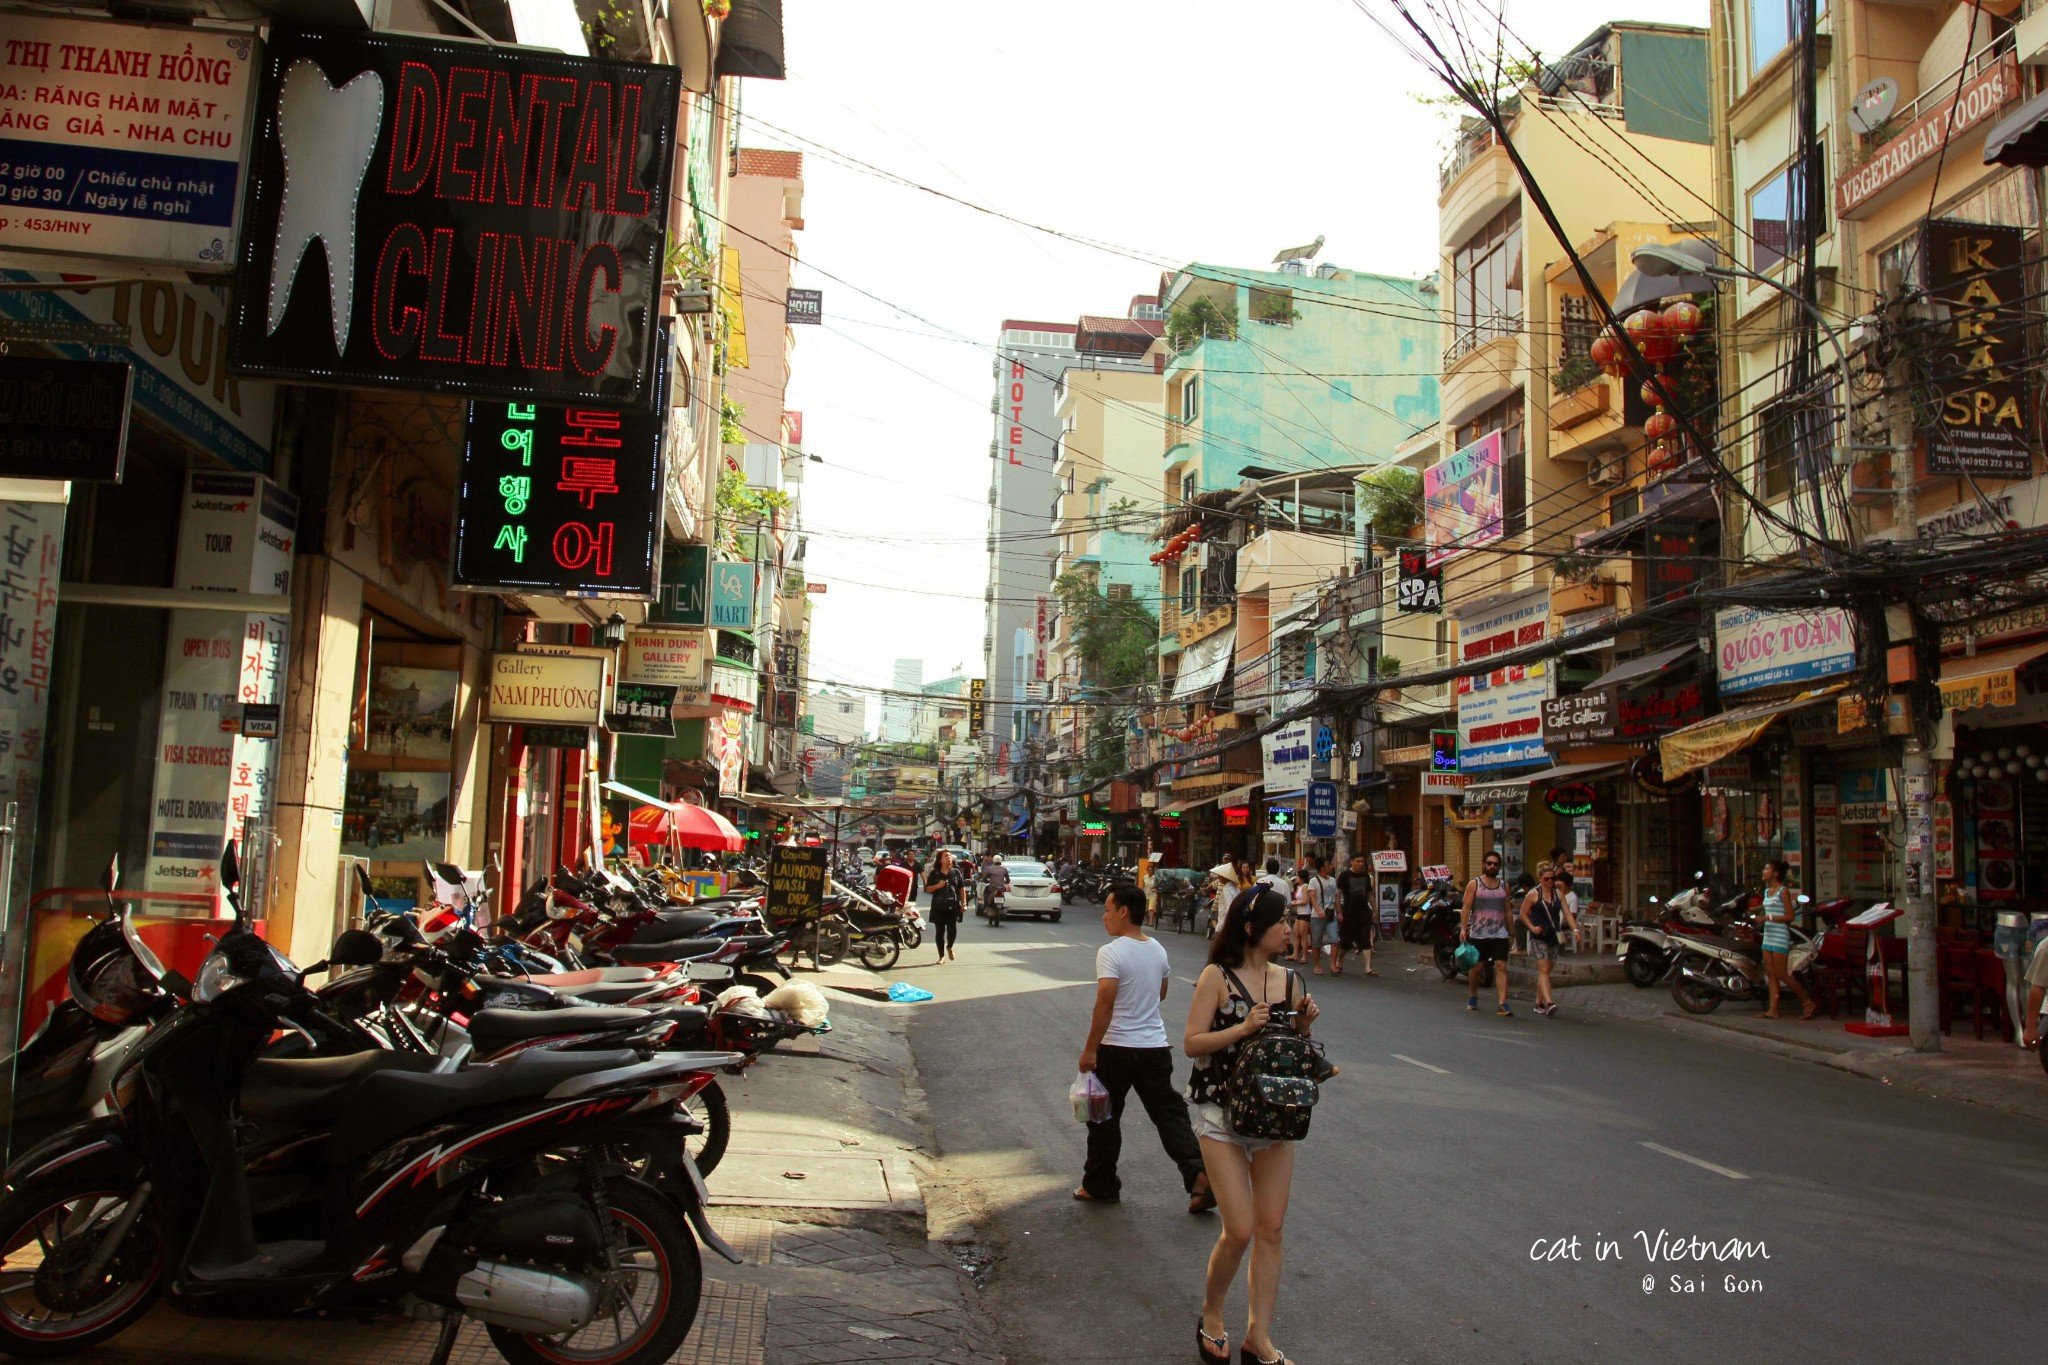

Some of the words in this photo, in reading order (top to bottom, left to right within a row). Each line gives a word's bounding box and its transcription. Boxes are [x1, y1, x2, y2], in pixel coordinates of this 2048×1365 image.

[6, 40, 51, 73] THỊ
[60, 44, 151, 79] THANH
[157, 42, 231, 86] HỒNG
[34, 84, 100, 109] RĂNG
[109, 90, 160, 114] HÀM
[167, 97, 218, 119] MẶT
[66, 113, 104, 136] GIẢ
[128, 123, 175, 144] NHA
[183, 128, 232, 148] CHU
[385, 60, 652, 217] DENTAL
[1841, 117, 1940, 207] VEGETARIAN
[1943, 73, 2004, 138] FOODS
[14, 164, 41, 180] giờ
[45, 166, 65, 181] 00
[88, 169, 137, 188] Chiều
[141, 174, 172, 192] chủ
[177, 179, 214, 197] nhật
[11, 185, 38, 202] giờ
[42, 188, 62, 202] 30
[84, 191, 128, 210] Ngày
[24, 218, 91, 236] 453/HNY
[371, 221, 623, 377] CLINIC
[789, 300, 819, 314] HOTEL
[1009, 359, 1025, 465] HOTEL
[1942, 389, 2024, 430] SPA
[192, 500, 233, 511] Jetstar
[205, 533, 233, 553] TOUR
[1400, 578, 1441, 606] SPA
[713, 605, 748, 624] MART
[183, 638, 209, 658] OPEN
[212, 639, 231, 659] BUS
[1722, 621, 1776, 672] QUỐC
[643, 652, 691, 663] GALLERY
[497, 658, 544, 680] Gallery
[1988, 675, 2008, 690] 138
[168, 690, 198, 711] TRAIN
[492, 684, 528, 707] NAM
[531, 684, 598, 710] PHƯƠNG
[972, 680, 985, 731] HOTEL
[250, 721, 273, 731] VISA
[1548, 710, 1572, 728] Cafe
[164, 744, 184, 764] VISA
[187, 746, 232, 767] SERVICES
[1434, 750, 1457, 769] Spa
[1428, 774, 1474, 786] INTERNET
[157, 798, 186, 819] HOTEL
[188, 799, 227, 821] BOOKING
[1840, 805, 1881, 820] Jetstar
[155, 864, 200, 879] Jetstar
[774, 863, 822, 880] LAUNDRY
[773, 879, 806, 891] WASH
[787, 892, 810, 905] DRY
